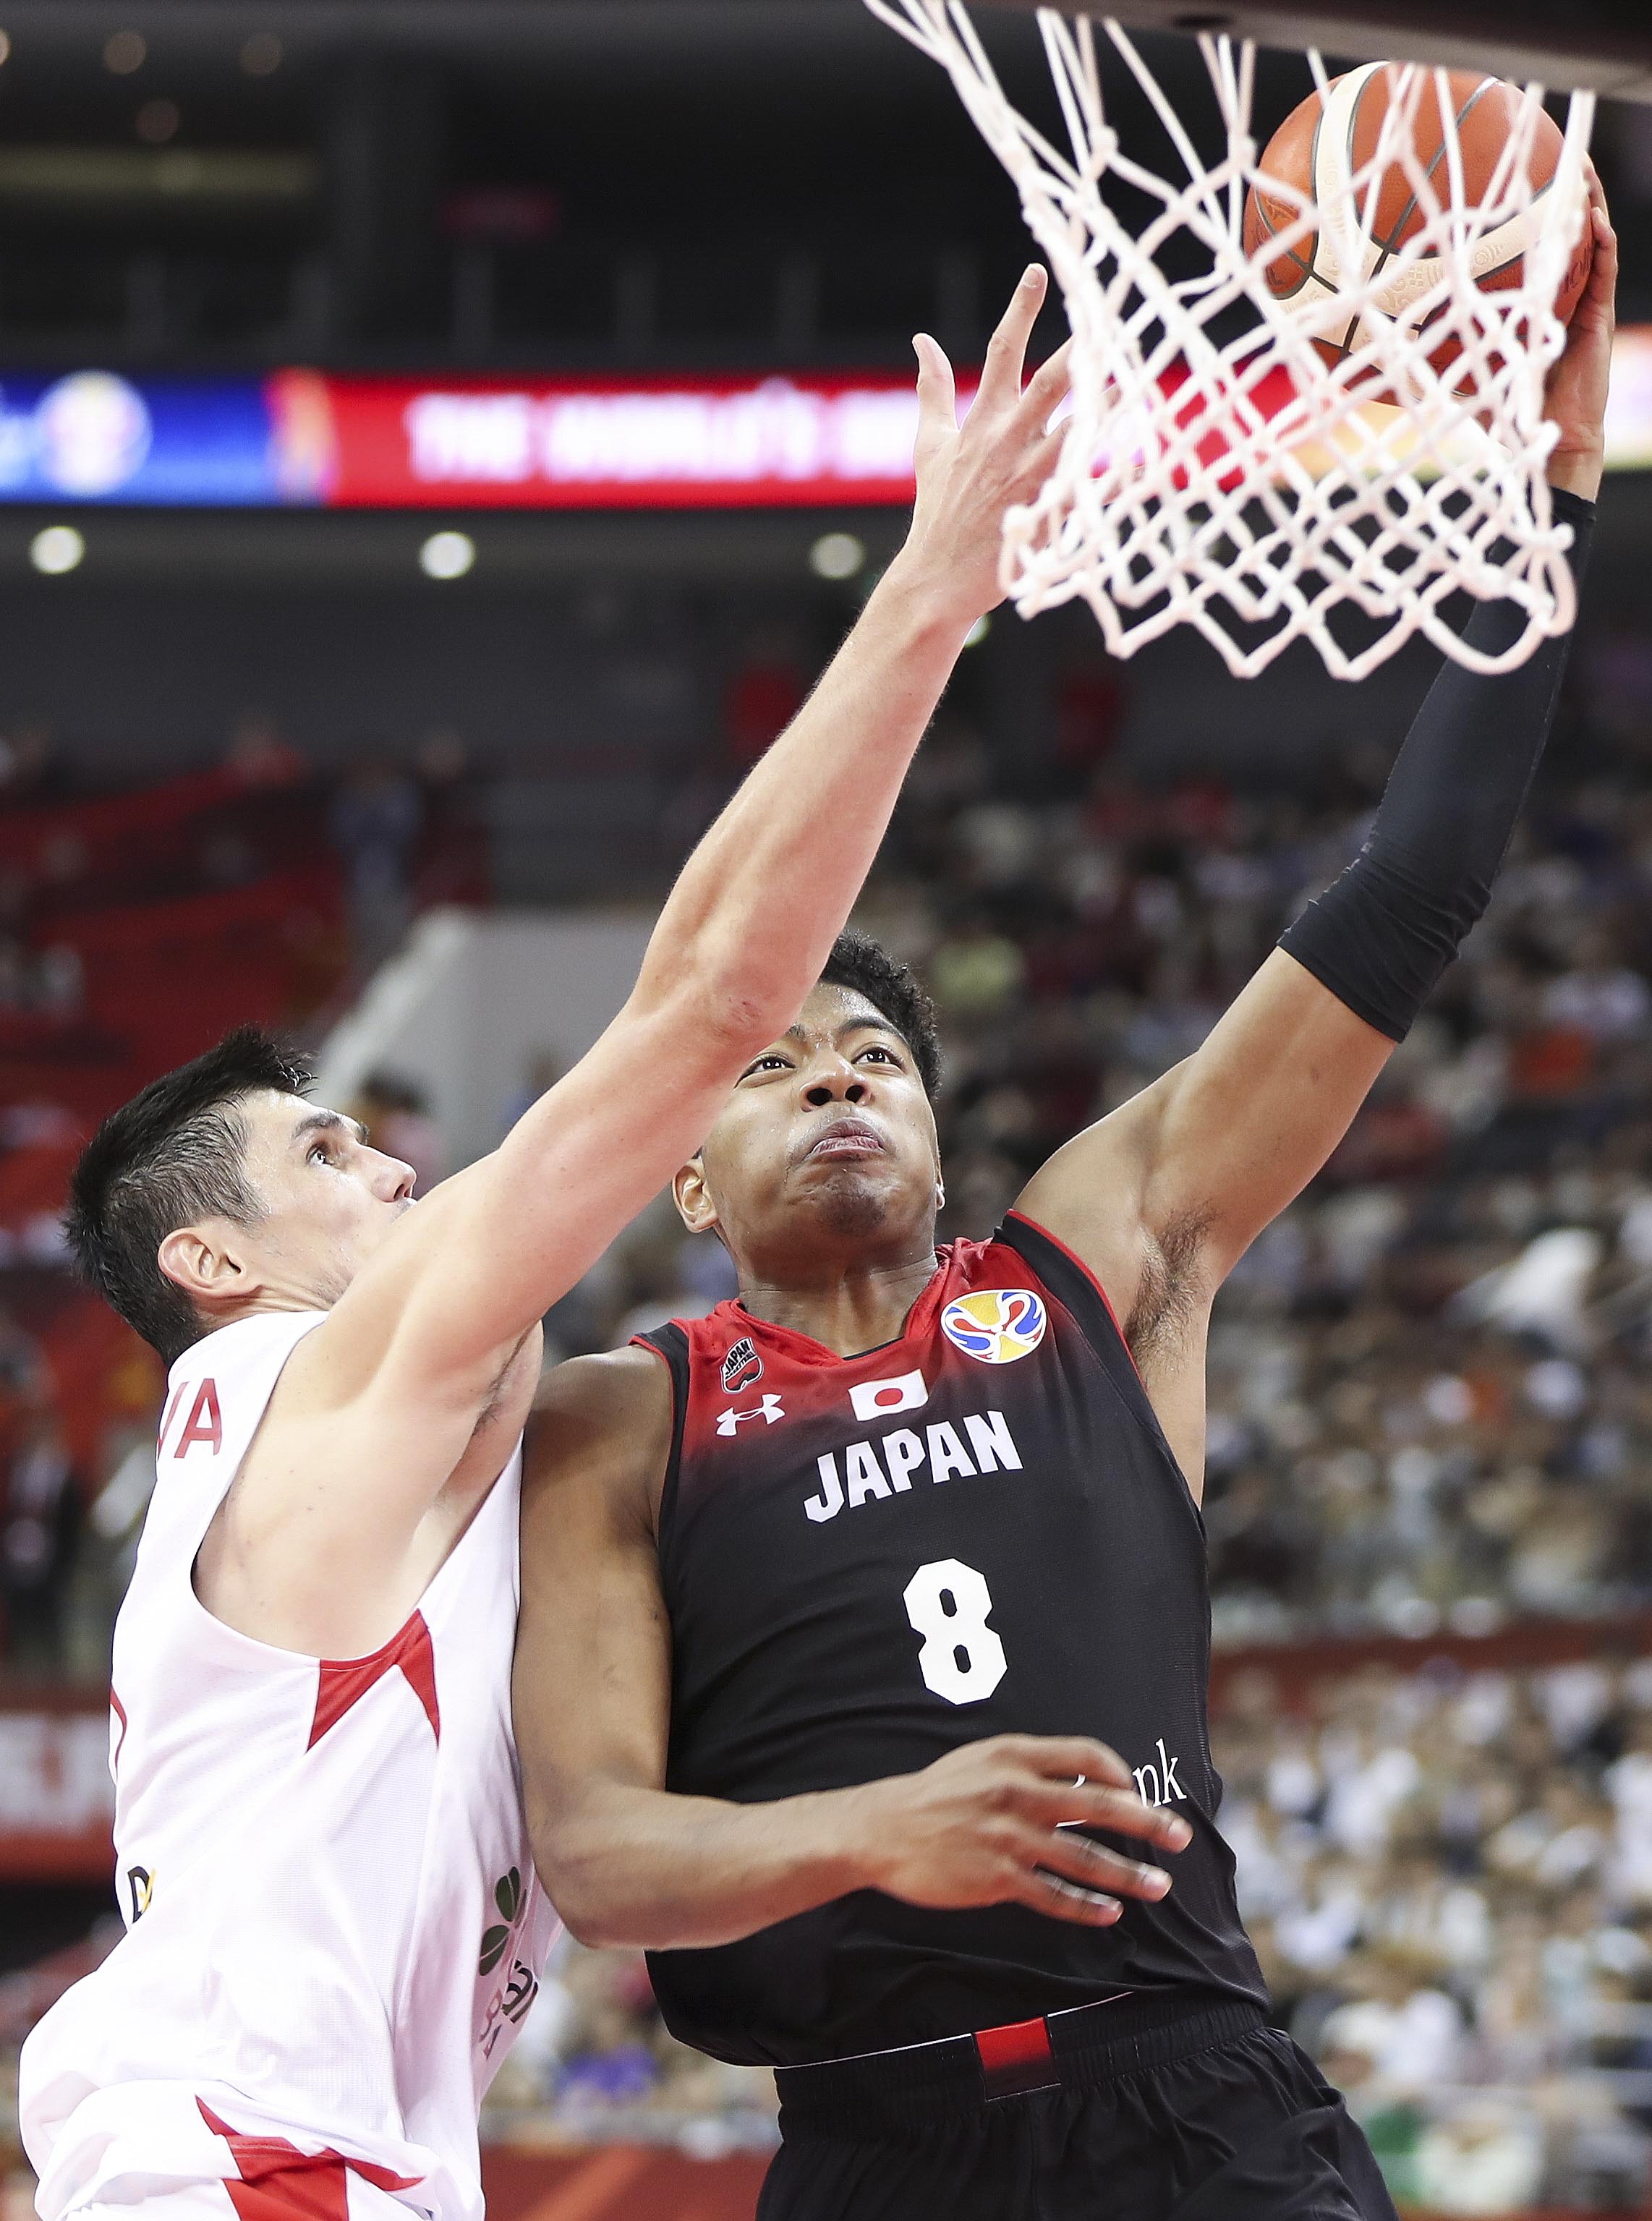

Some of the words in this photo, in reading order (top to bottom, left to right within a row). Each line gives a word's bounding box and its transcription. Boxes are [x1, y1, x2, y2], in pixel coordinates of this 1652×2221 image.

[725, 1340, 751, 1376] JAPAN
[804, 1410, 1023, 1523] JAPAN
[902, 1558, 1008, 1705] 8
